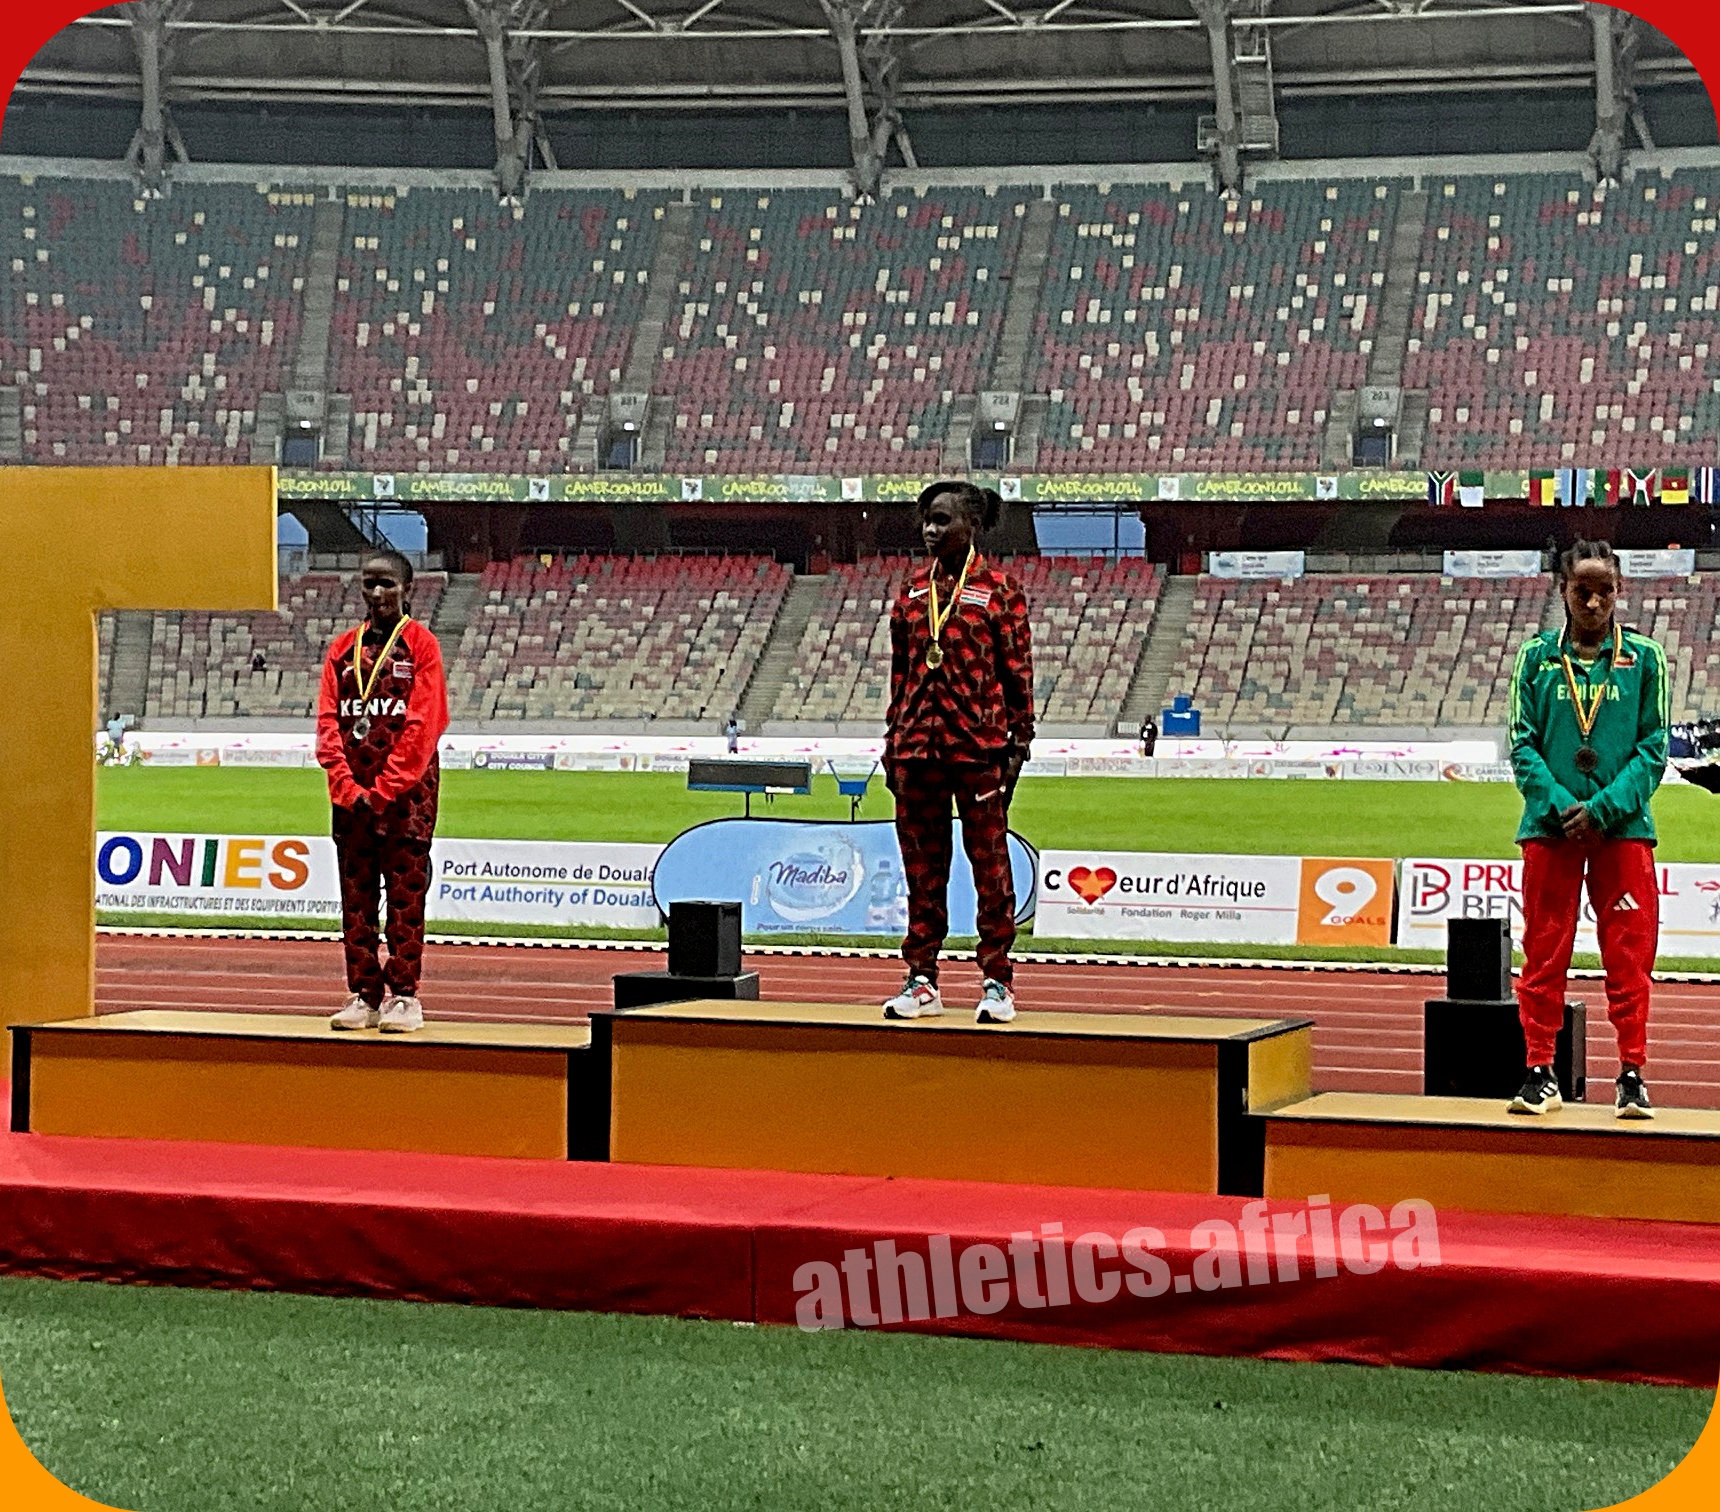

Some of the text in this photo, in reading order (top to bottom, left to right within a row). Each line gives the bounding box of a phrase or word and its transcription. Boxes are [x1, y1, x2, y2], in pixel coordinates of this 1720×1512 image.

[340, 698, 406, 717] KENYA
[97, 836, 310, 890] ONIES
[442, 860, 477, 876] Port
[481, 862, 567, 879] Autonome
[573, 865, 593, 879] de
[769, 861, 847, 888] Madiba
[131, 895, 146, 908] DES
[223, 897, 233, 911] ET
[235, 898, 249, 911] DES
[439, 884, 655, 908] Port Authority of Douala
[1314, 867, 1377, 926] 9
[1121, 907, 1172, 919] Fondation
[1180, 909, 1211, 922] Roger
[1215, 910, 1242, 921] Milla
[1330, 915, 1387, 926] GOALS
